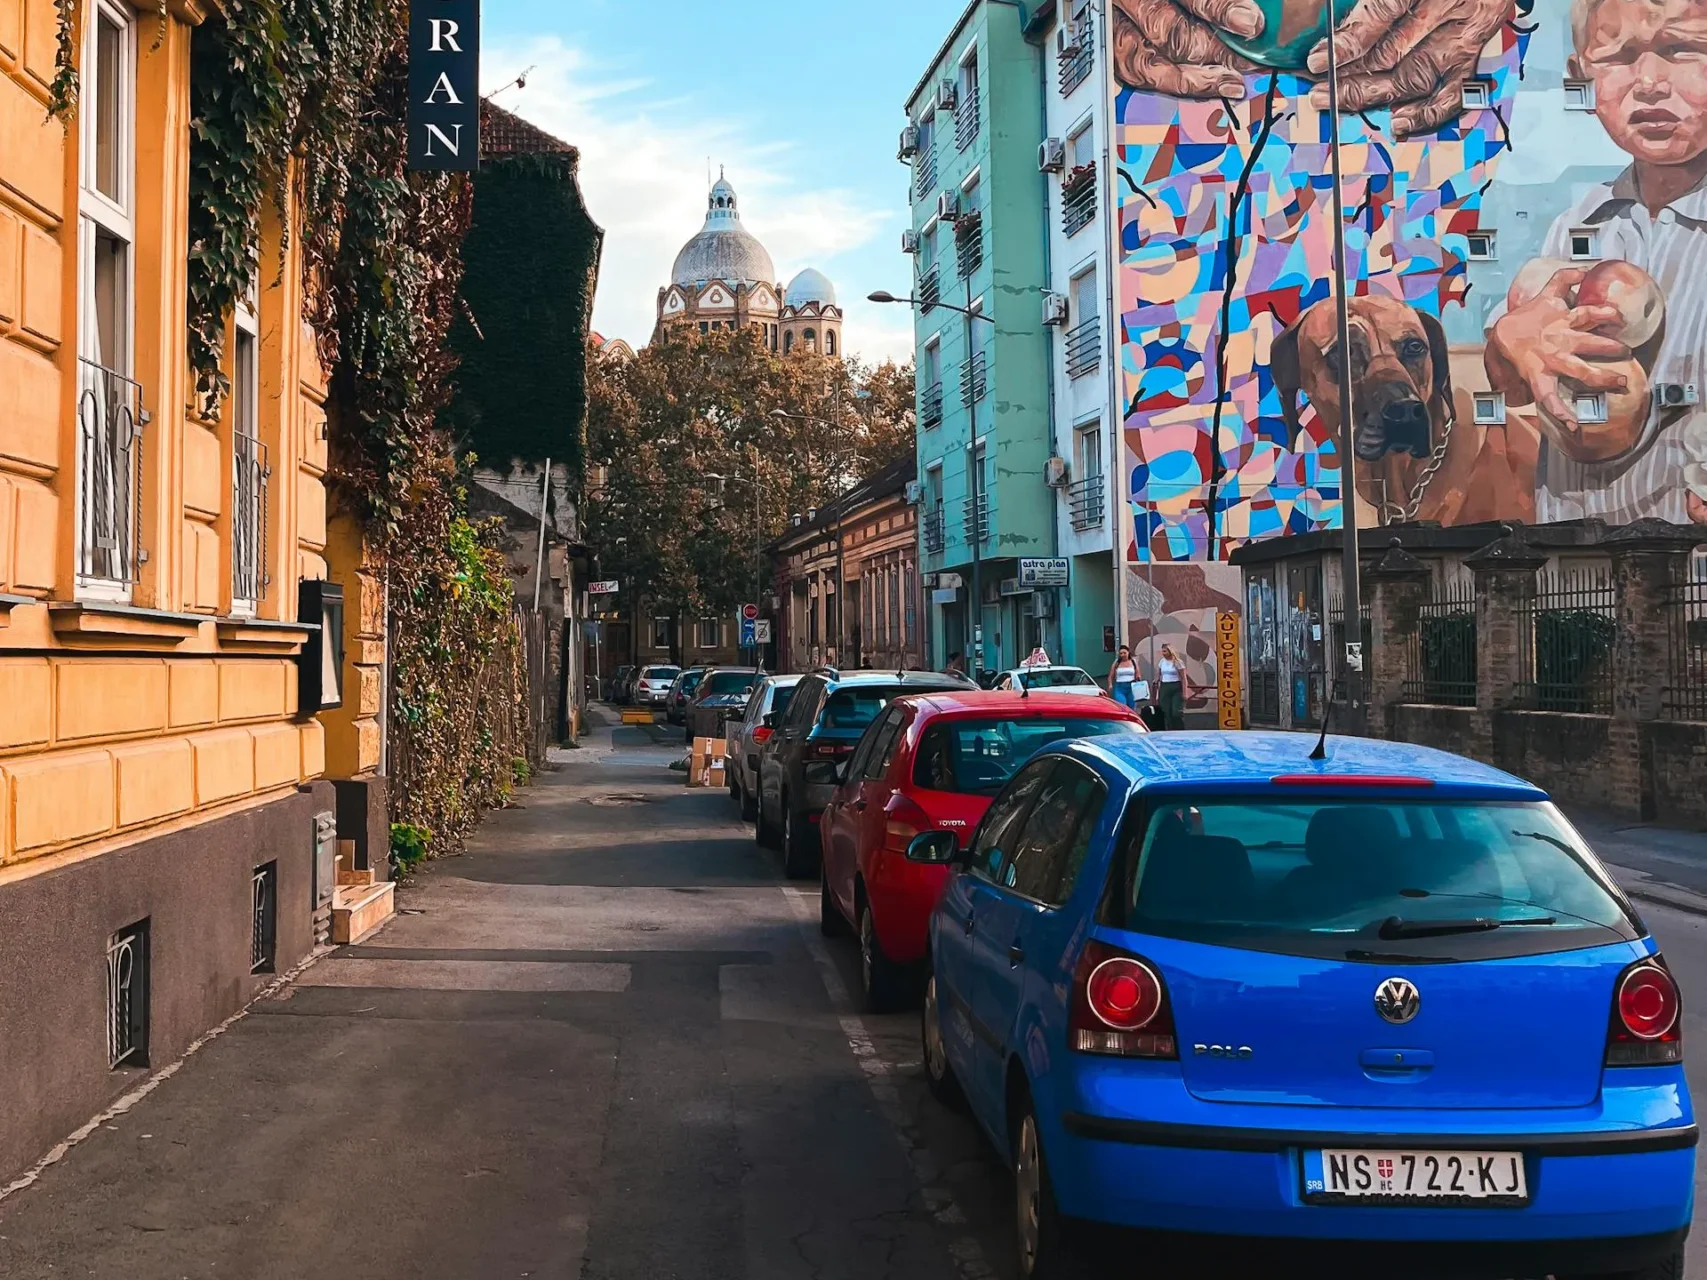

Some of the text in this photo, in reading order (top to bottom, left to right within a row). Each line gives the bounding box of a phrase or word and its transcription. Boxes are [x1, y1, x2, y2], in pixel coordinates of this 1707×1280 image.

[1022, 559, 1066, 569] astra plan
[590, 582, 609, 592] INSEL
[1220, 613, 1237, 730] AUTOPERIONIC
[1194, 1044, 1252, 1058] POLO
[1330, 1154, 1371, 1190] NS
[1307, 1180, 1323, 1189] SRB
